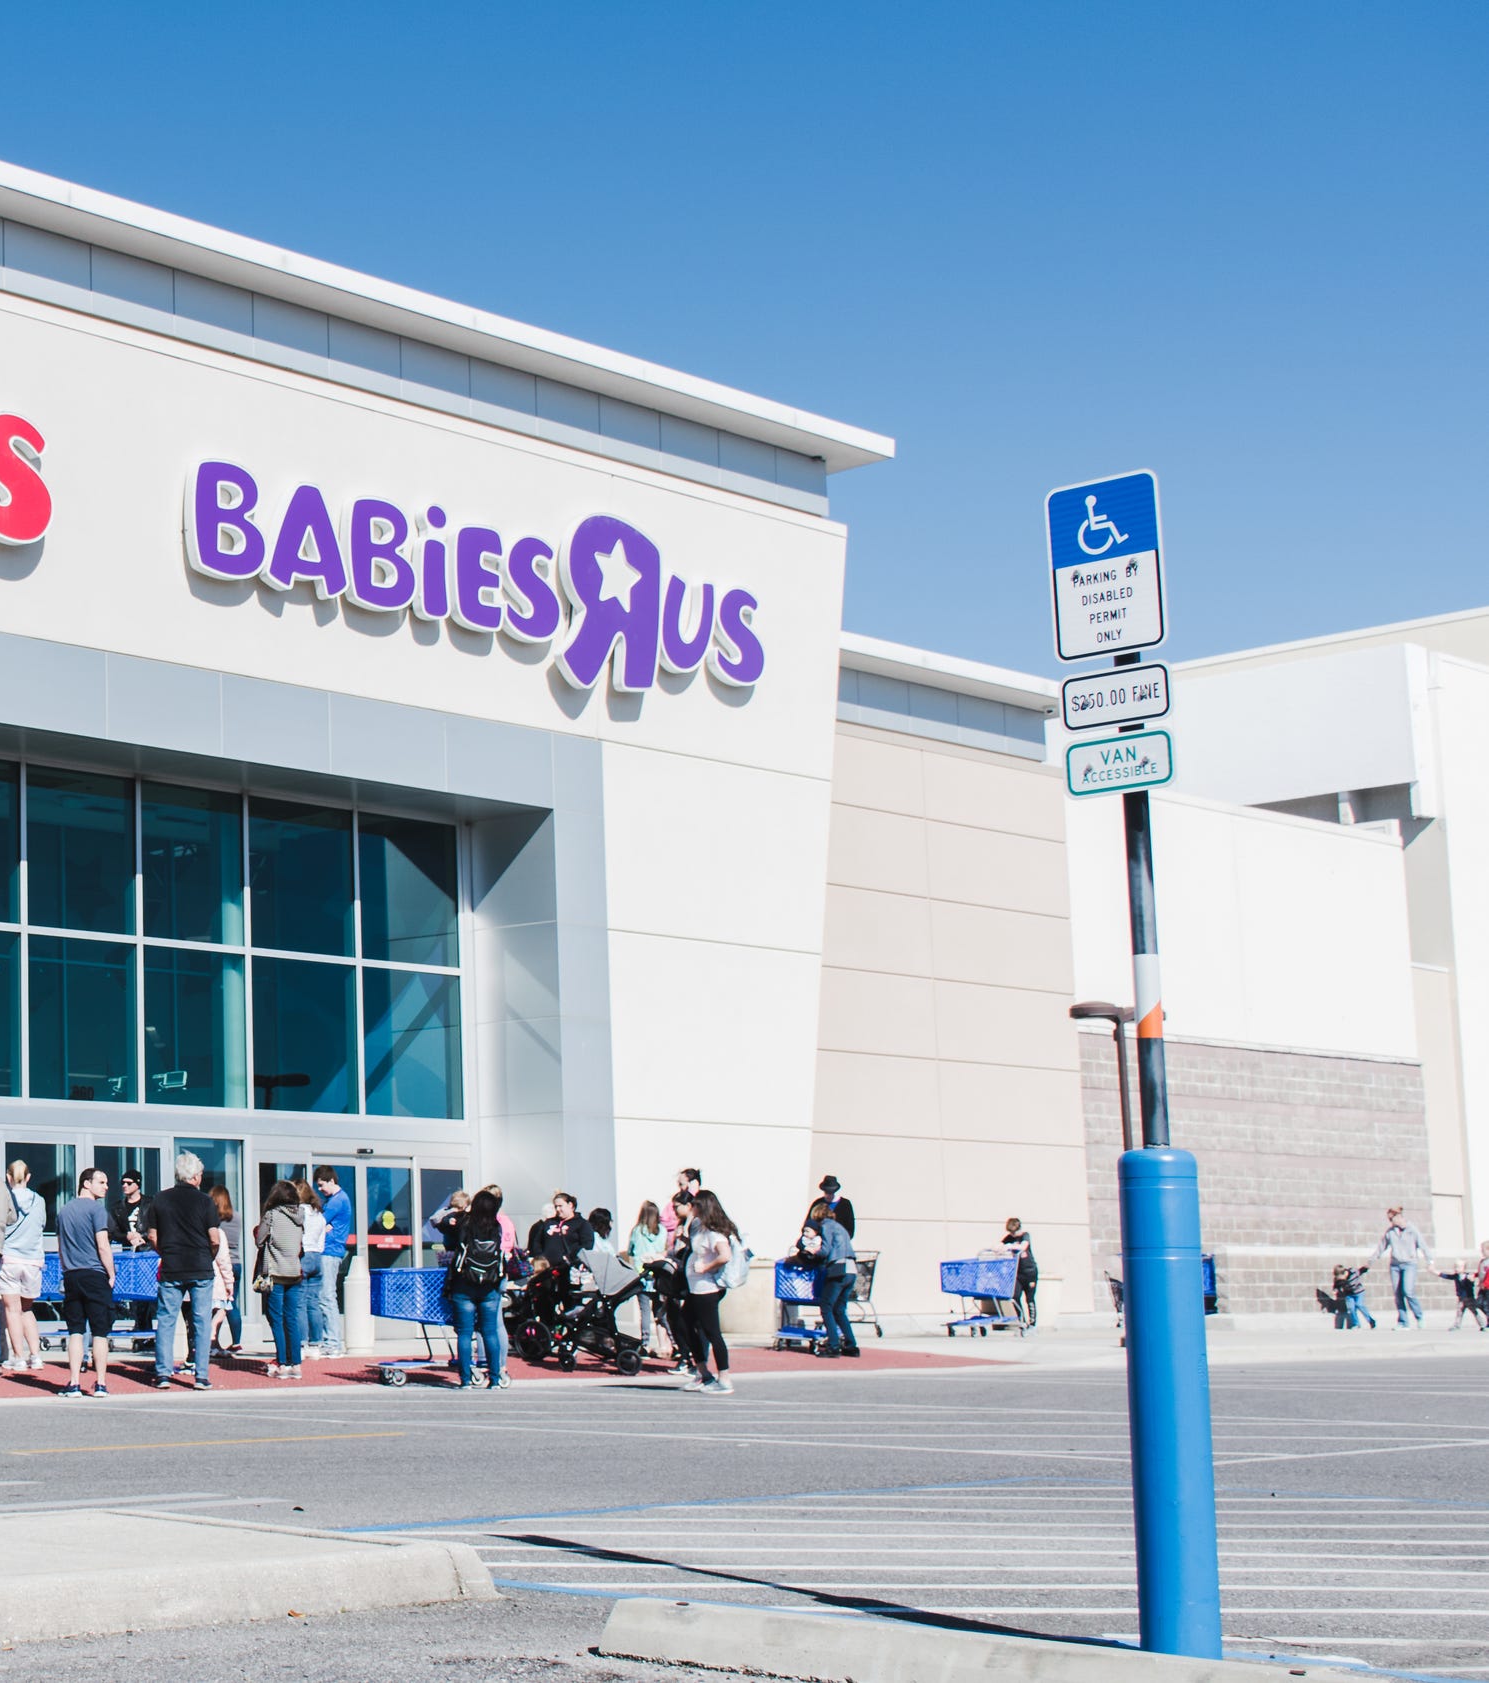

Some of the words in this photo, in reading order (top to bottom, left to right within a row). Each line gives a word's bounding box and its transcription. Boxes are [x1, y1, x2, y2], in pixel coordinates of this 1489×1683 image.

[1072, 568, 1117, 588] PARKING
[1125, 564, 1139, 578] BY
[560, 514, 662, 691] R
[1081, 586, 1133, 606] DISABLED
[1089, 607, 1127, 625] PERMIT
[1096, 628, 1122, 644] ONLY
[1071, 687, 1126, 712] $250.00
[1132, 682, 1160, 702] FINE
[1100, 745, 1137, 766] VAN
[1082, 762, 1158, 784] ACCESSIBLE
